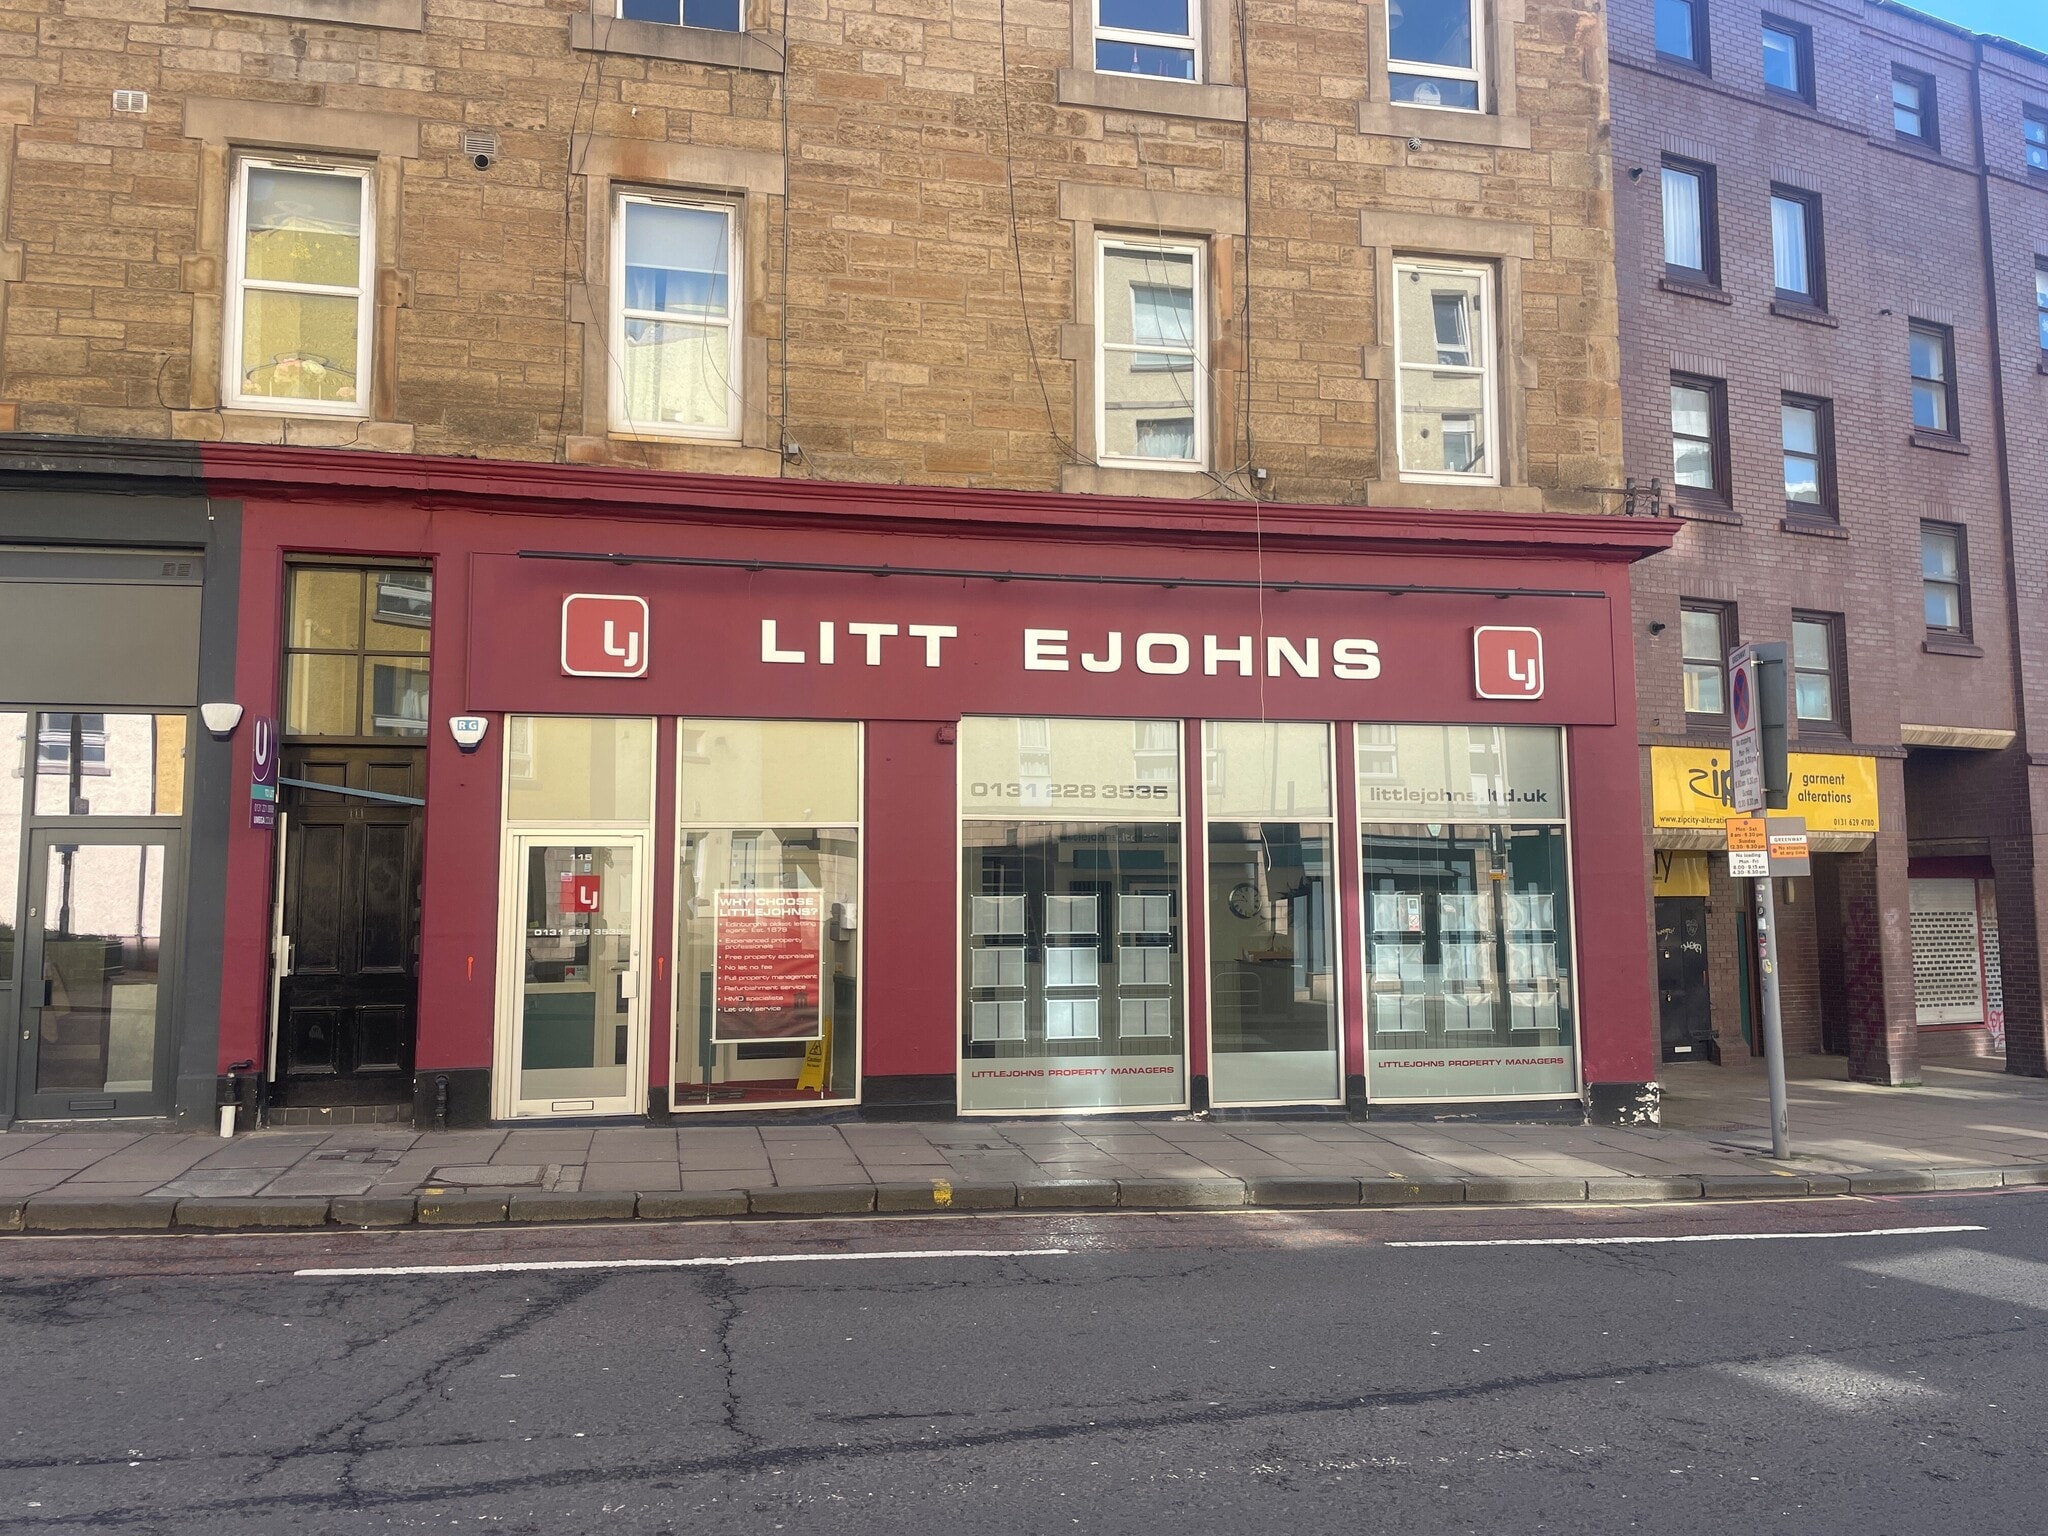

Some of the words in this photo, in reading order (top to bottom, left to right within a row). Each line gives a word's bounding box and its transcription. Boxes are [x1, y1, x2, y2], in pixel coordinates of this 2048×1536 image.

[760, 619, 958, 668] LITT
[1024, 628, 1382, 681] EJOHNS
[1802, 774, 1845, 787] garment
[970, 782, 1040, 798] 0131
[1046, 783, 1097, 799] 228
[1101, 785, 1169, 800] 3535
[1797, 790, 1852, 803] alterations
[570, 853, 593, 861] 115
[719, 898, 752, 906] WHY
[756, 897, 814, 906] CHOOSE
[719, 908, 818, 917] LITTLEJOHNS?
[1378, 1060, 1445, 1069] LITTLEJOHNS
[1448, 1059, 1502, 1067] PROPERTY
[1505, 1057, 1564, 1065] MANAGERS
[971, 1069, 1045, 1078] LITTLEJOHNS
[1048, 1068, 1107, 1077] PROPERTY
[1110, 1066, 1175, 1075] MANAGERS
